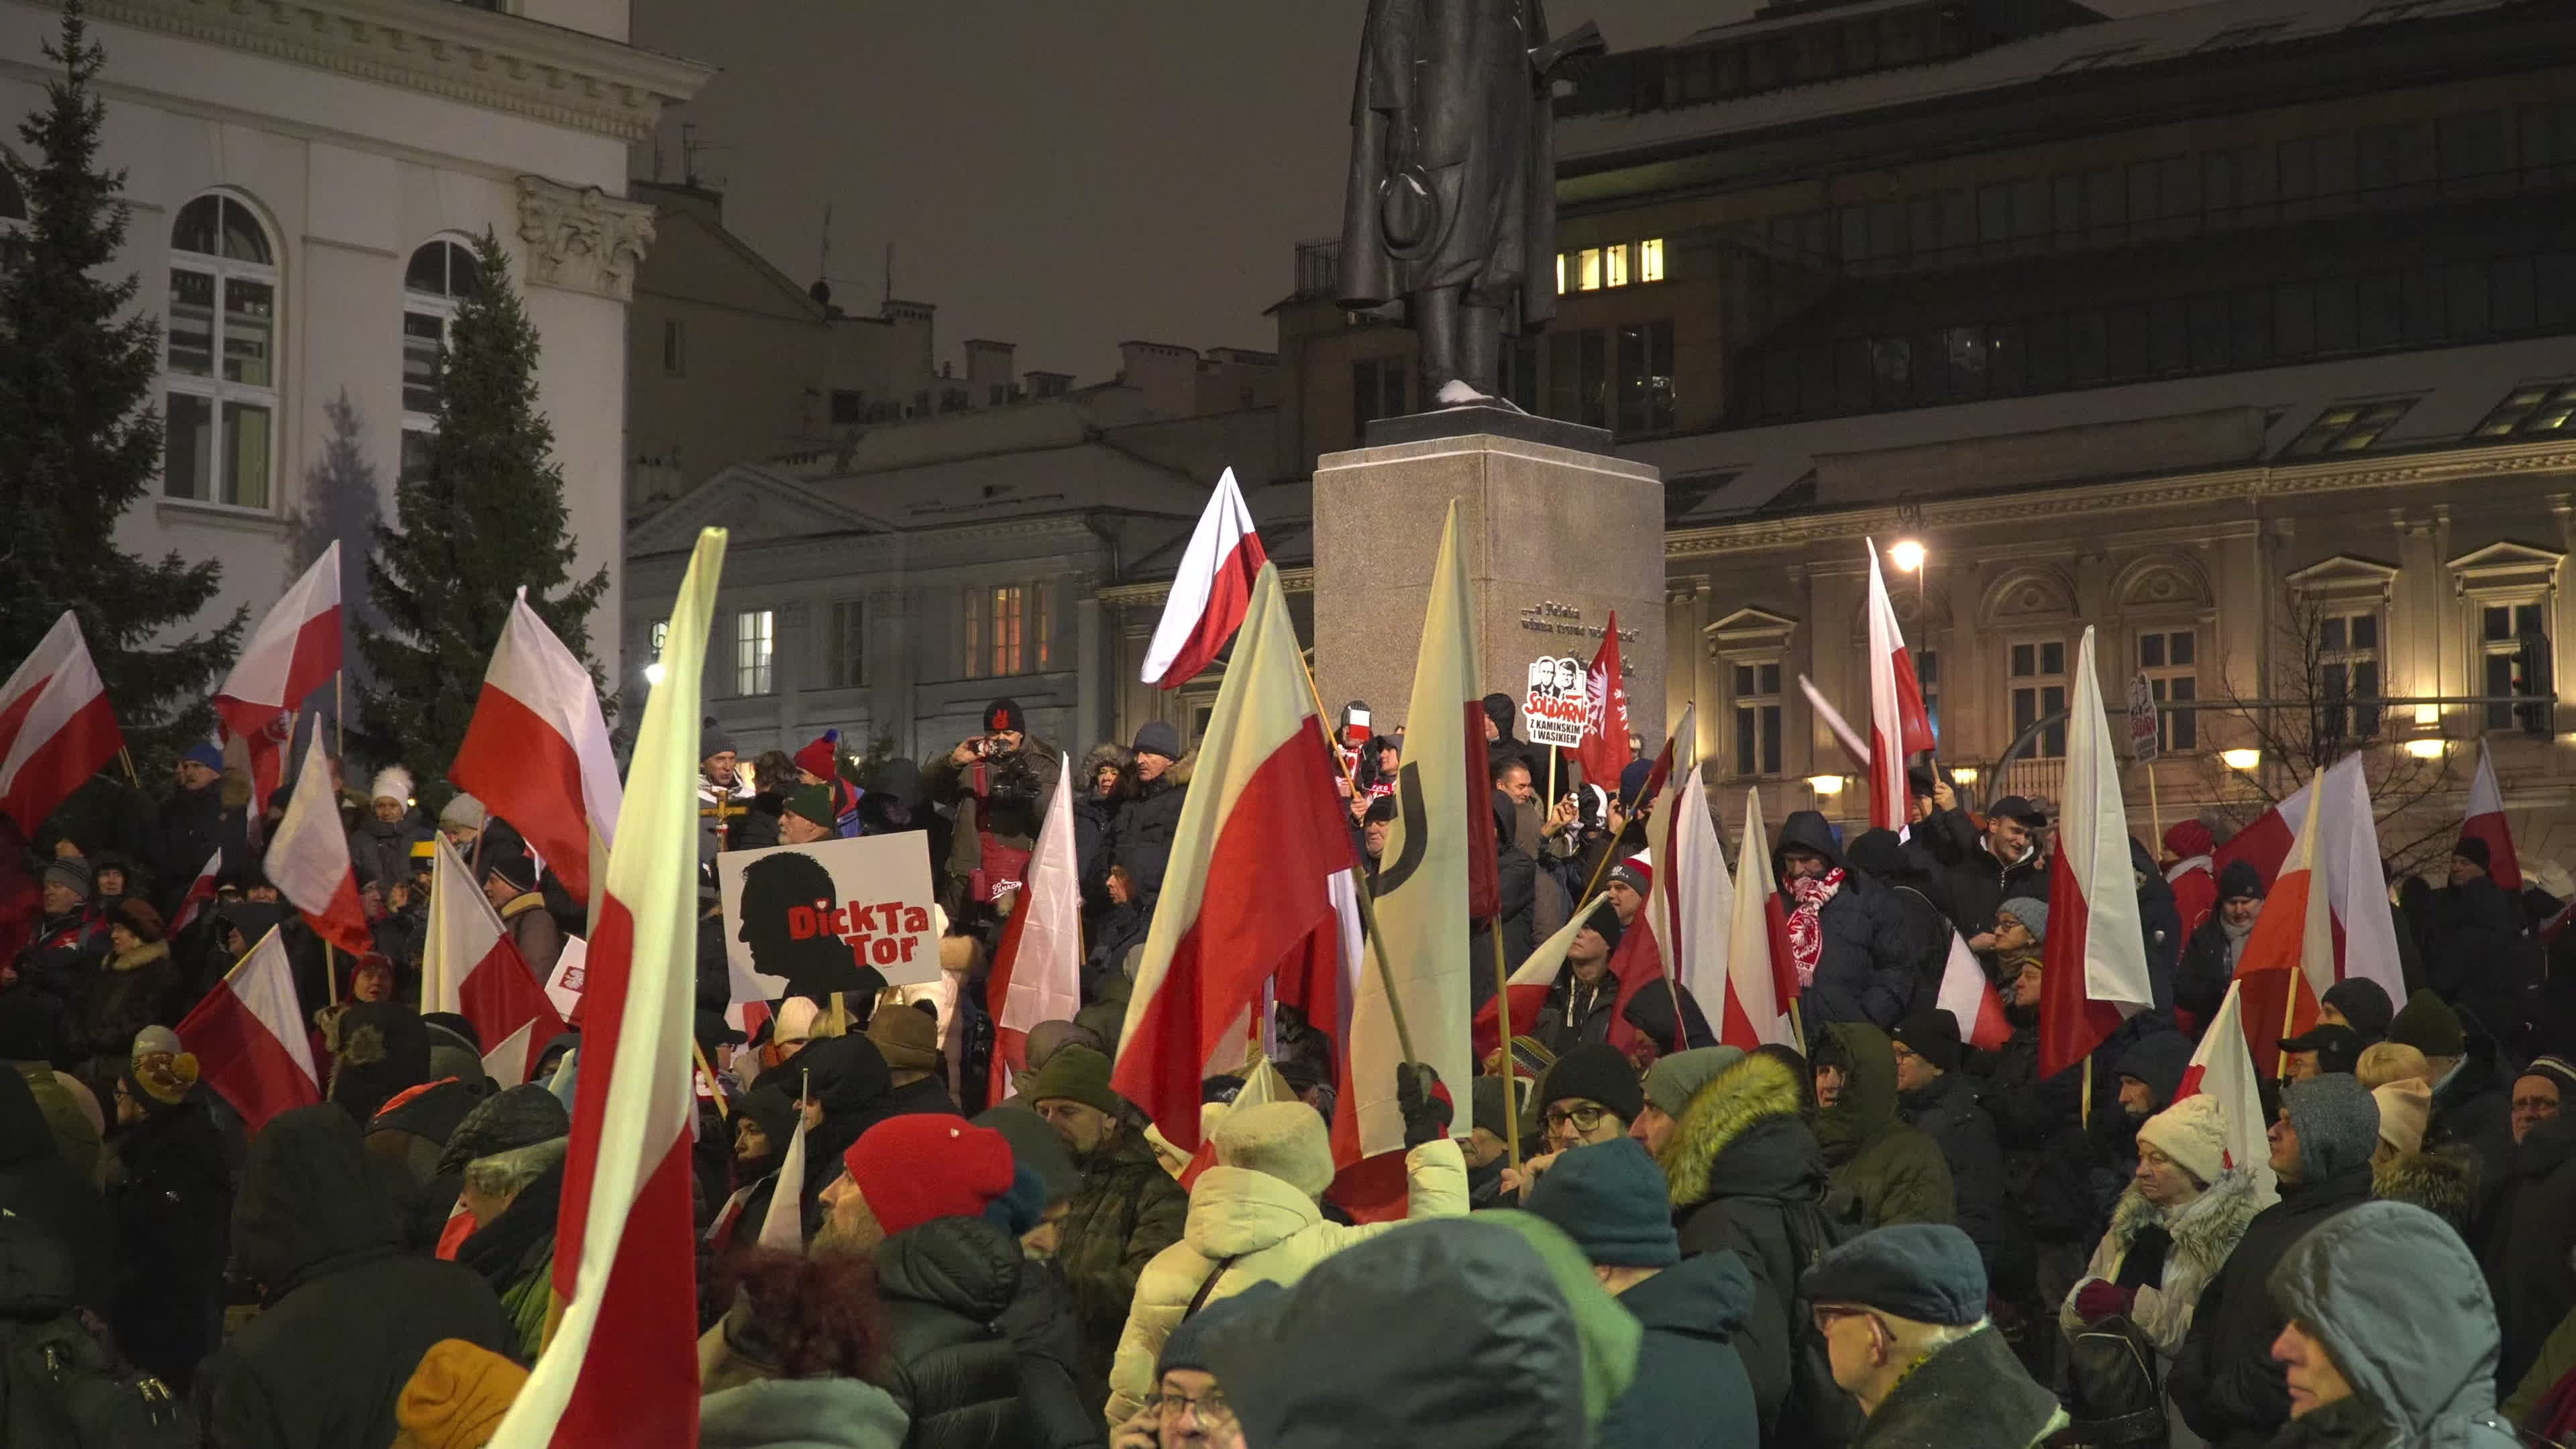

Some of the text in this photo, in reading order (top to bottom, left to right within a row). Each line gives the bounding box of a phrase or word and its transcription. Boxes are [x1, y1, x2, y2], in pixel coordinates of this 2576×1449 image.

[1530, 718, 1535, 728] Z
[1533, 729, 1536, 739] I
[993, 883, 1022, 895] CANADA
[844, 933, 918, 967] Tor
